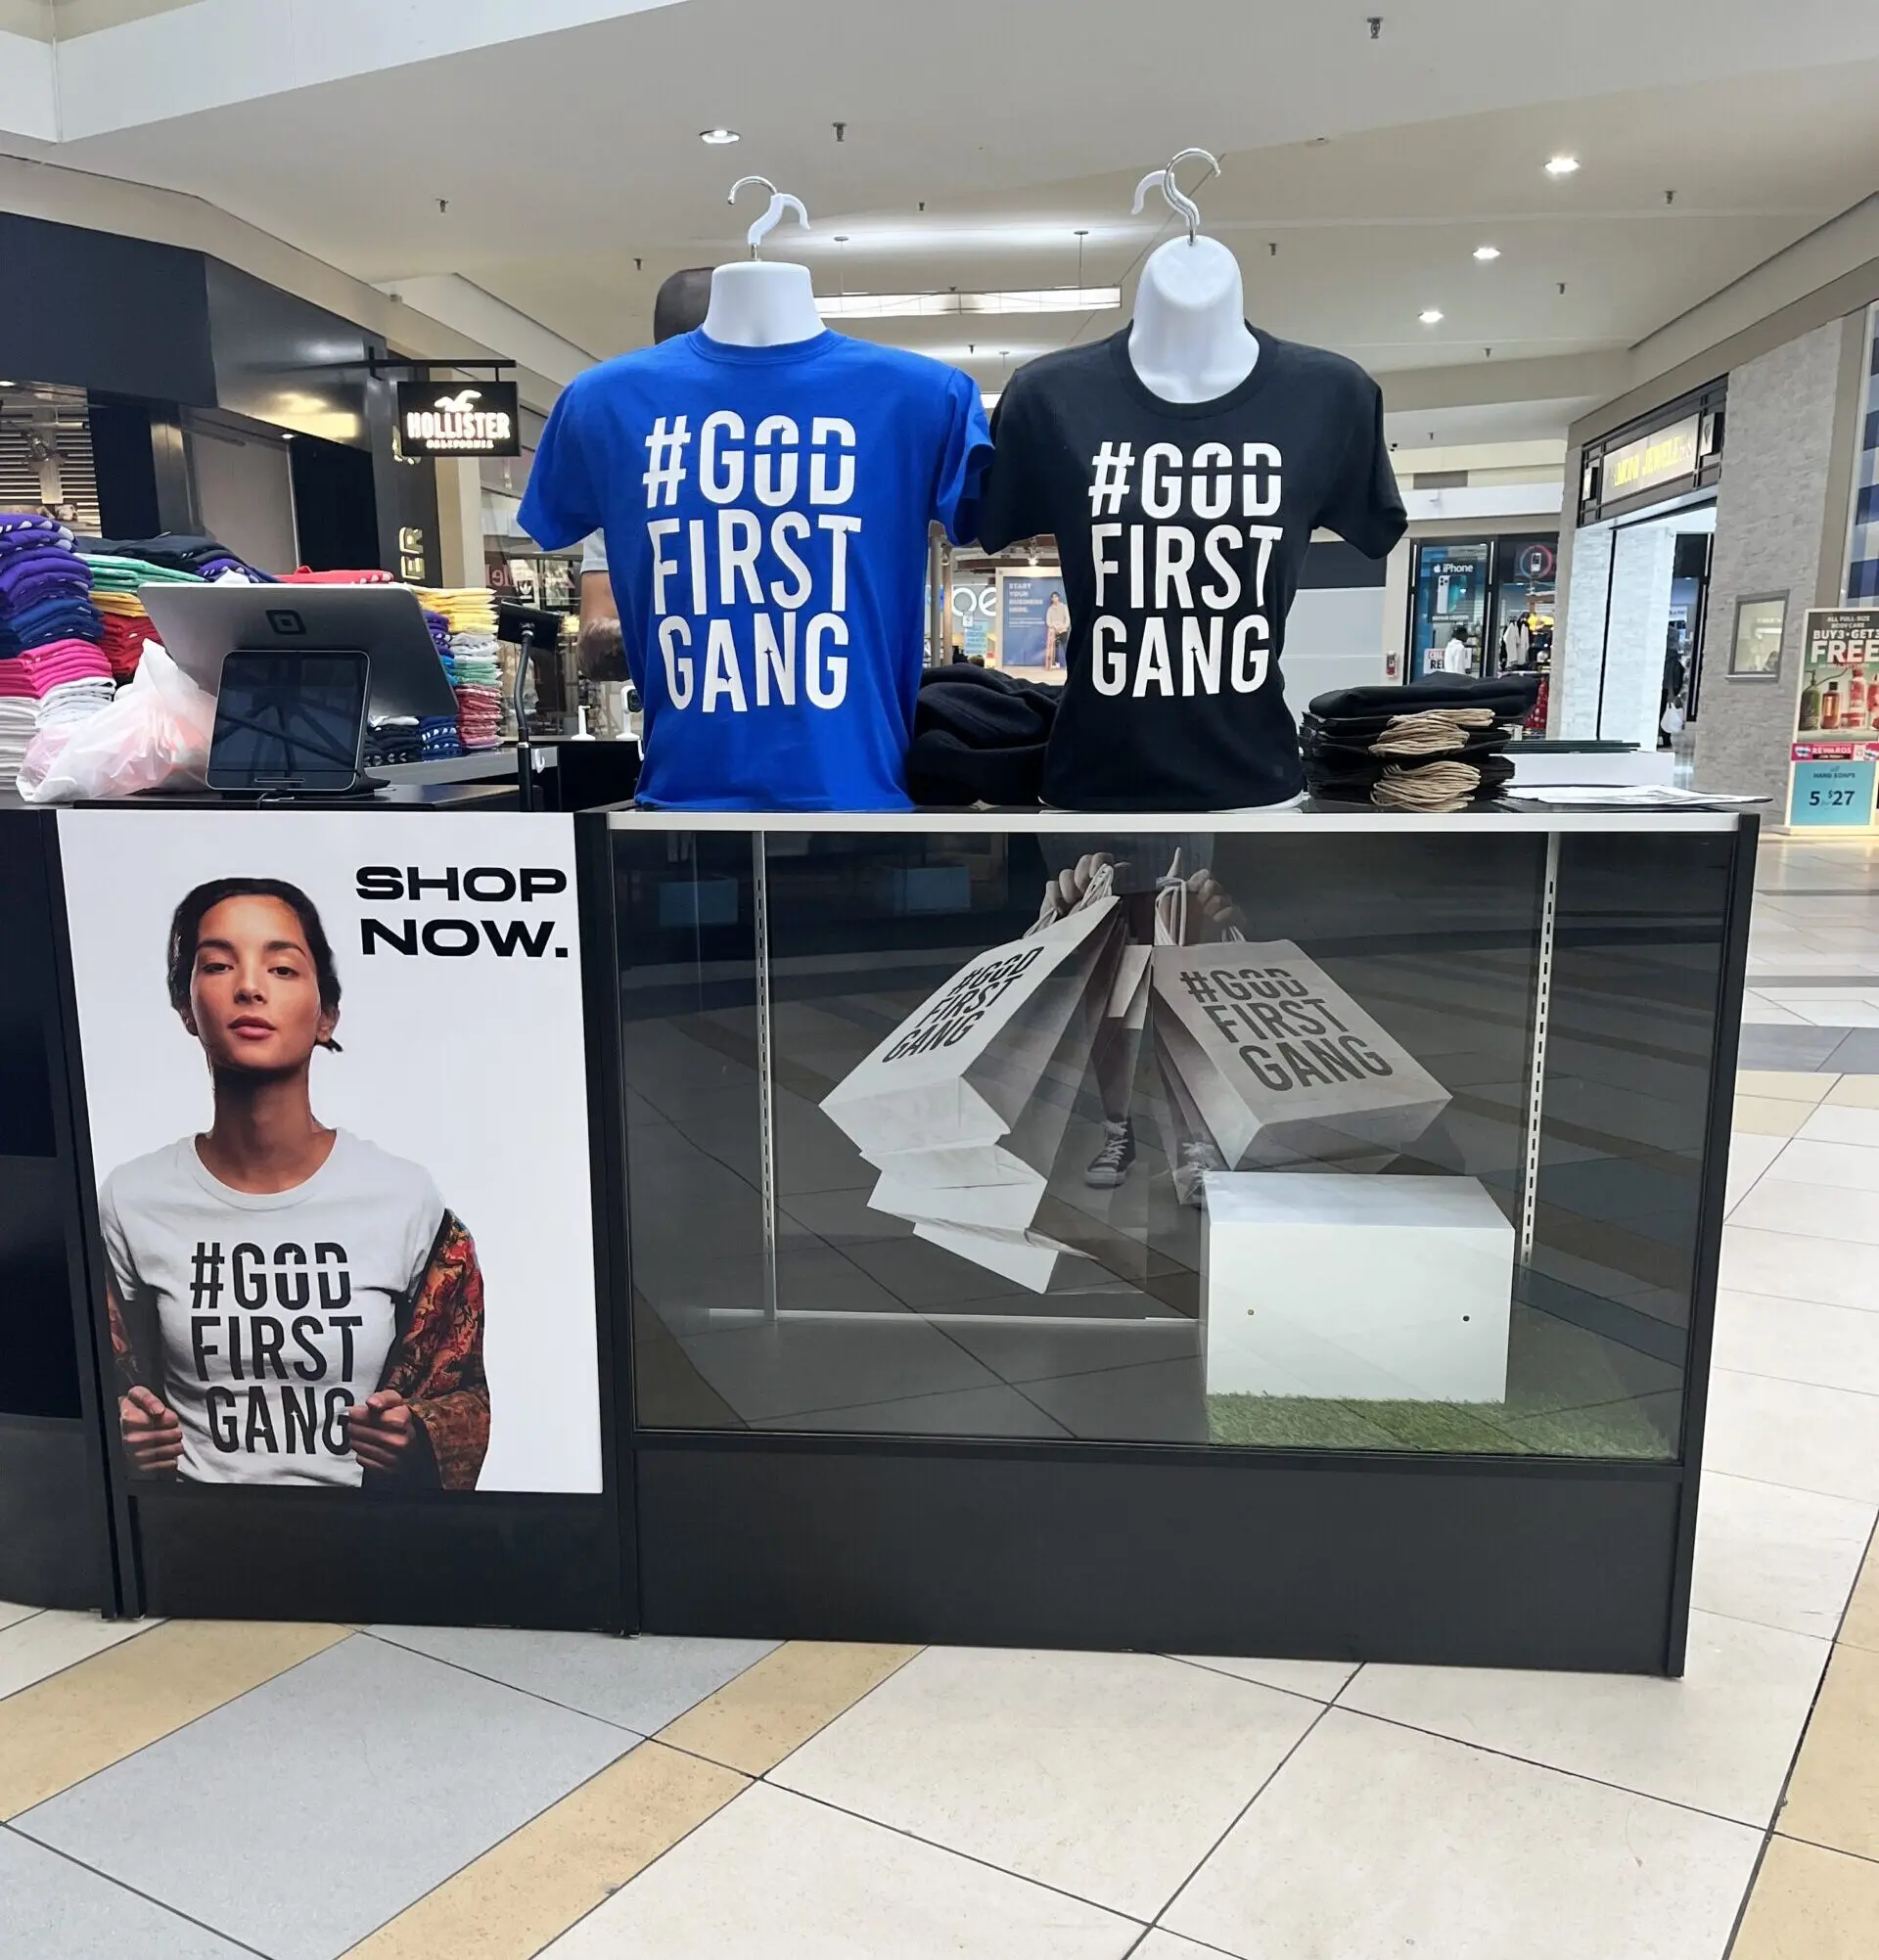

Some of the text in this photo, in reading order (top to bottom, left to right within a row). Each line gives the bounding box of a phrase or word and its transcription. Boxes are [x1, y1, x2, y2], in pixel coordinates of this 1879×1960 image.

[406, 411, 511, 439] HOLLISTER
[642, 410, 856, 508] #GOD
[1087, 441, 1282, 519] #GOD
[647, 509, 862, 615] FIRST
[1091, 523, 1284, 610] FIRST
[1443, 563, 1474, 573] iPhone
[658, 612, 849, 712] GANG
[1091, 615, 1270, 697] GANG
[1810, 639, 1879, 663] FREE
[1809, 790, 1856, 806] 5 $27
[355, 866, 568, 902] SHOP
[360, 918, 569, 958] NOW.
[946, 946, 1044, 997] #GOD
[1179, 968, 1308, 1003] #GOD
[915, 974, 1024, 1028] FIRST
[1202, 998, 1349, 1043] FIRST
[882, 1010, 985, 1064] GANG
[1238, 1035, 1394, 1091] GANG
[190, 1242, 351, 1310] #GOD
[191, 1315, 363, 1383] FIRST
[206, 1386, 355, 1455] GANG
